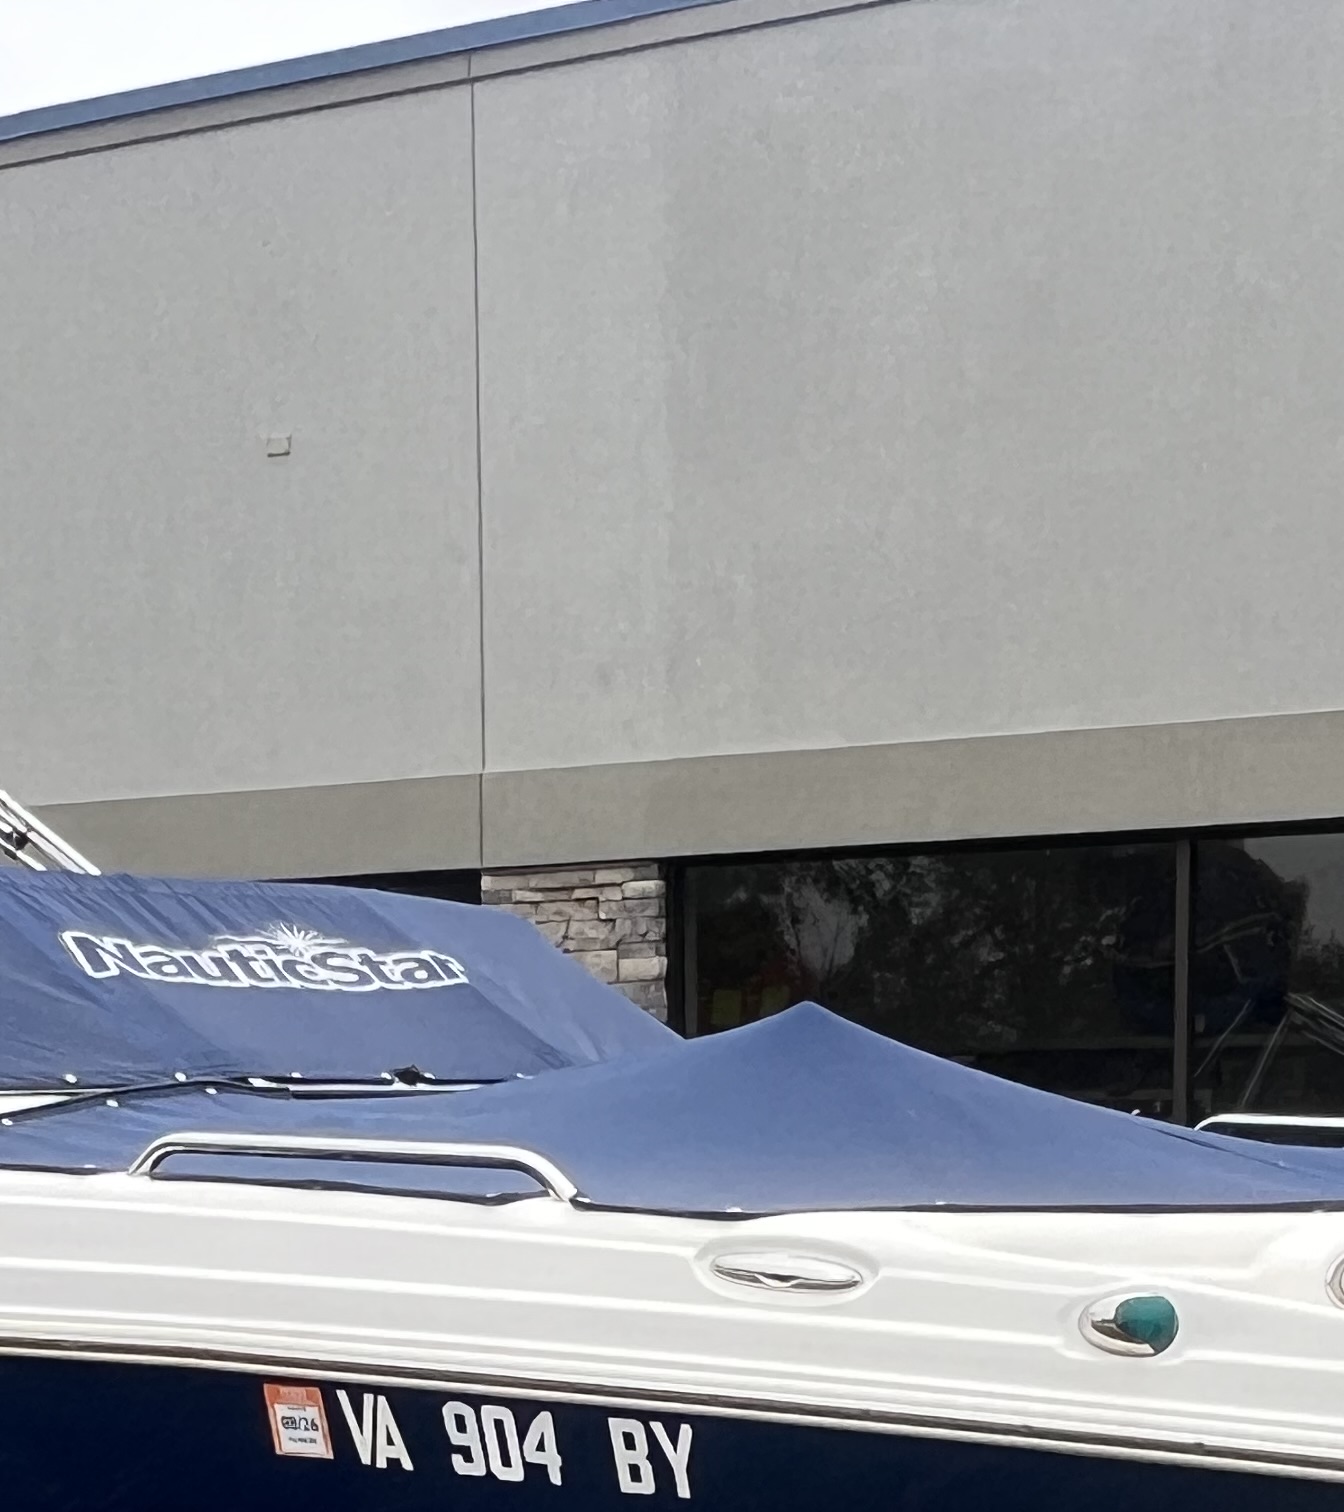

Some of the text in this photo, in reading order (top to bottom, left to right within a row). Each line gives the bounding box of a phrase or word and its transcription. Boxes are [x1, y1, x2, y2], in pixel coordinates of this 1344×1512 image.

[59, 929, 468, 991] NauticStar
[336, 1389, 692, 1499] VA 904 BY
